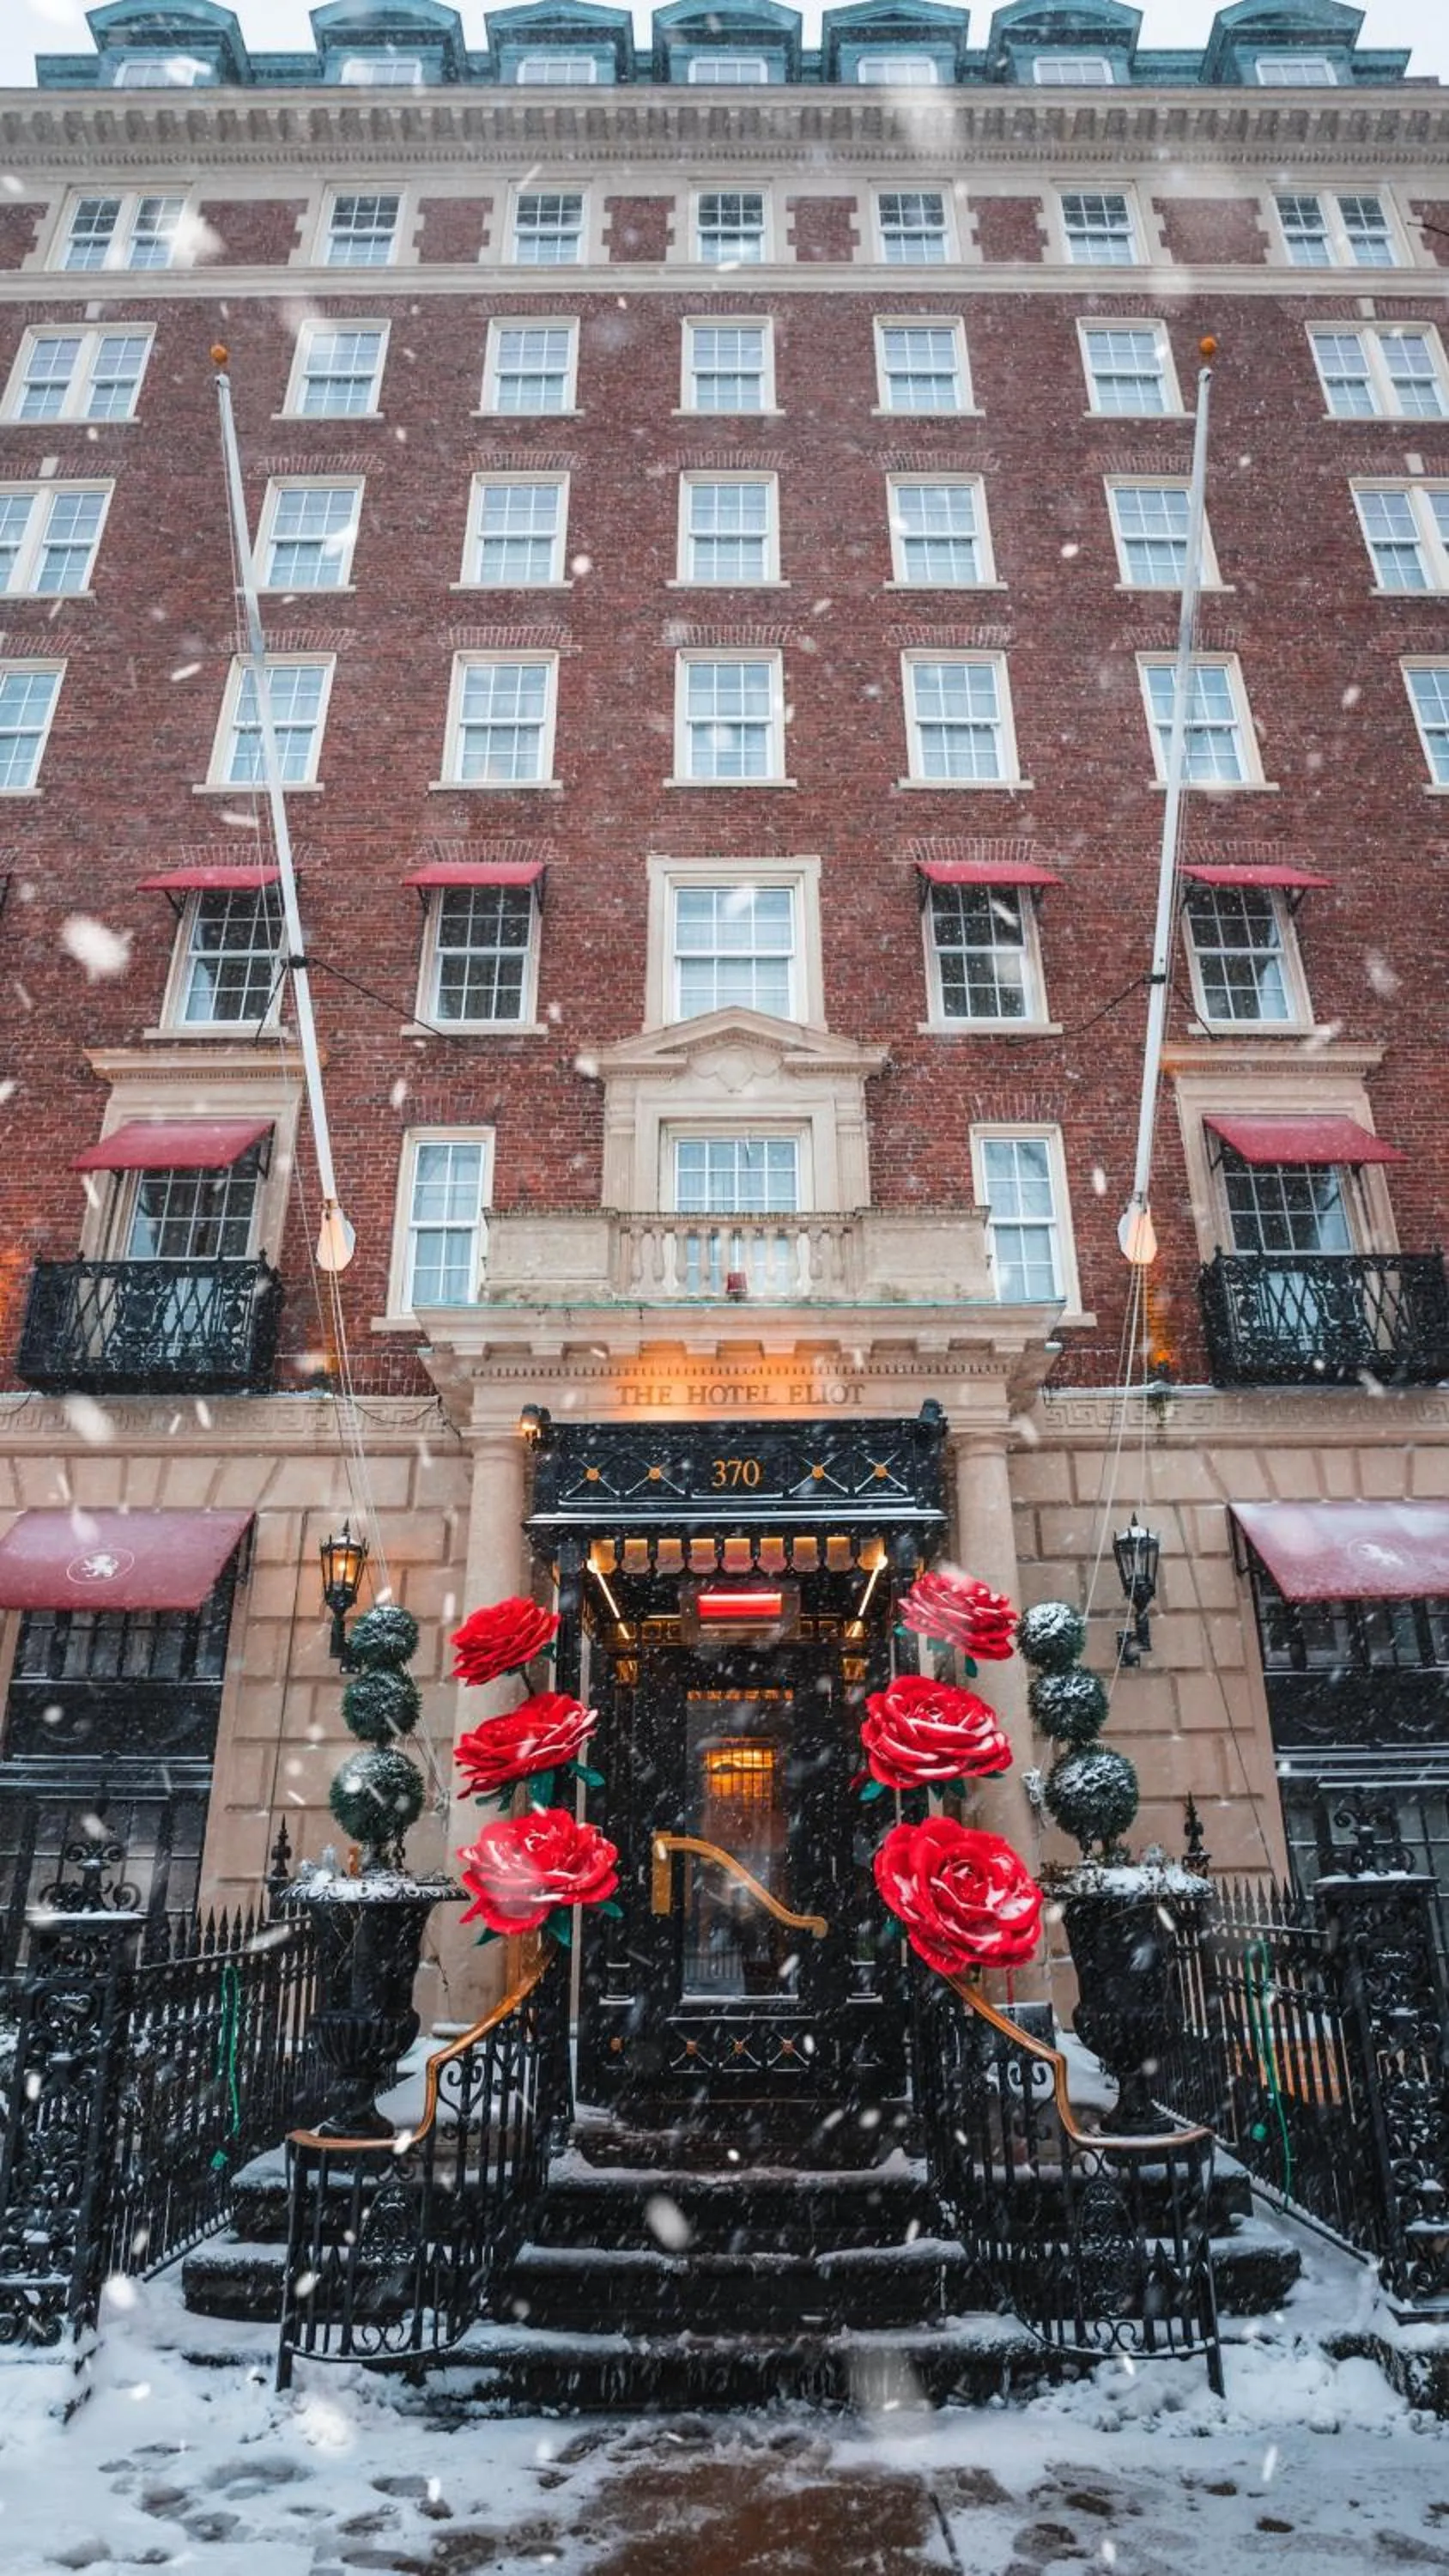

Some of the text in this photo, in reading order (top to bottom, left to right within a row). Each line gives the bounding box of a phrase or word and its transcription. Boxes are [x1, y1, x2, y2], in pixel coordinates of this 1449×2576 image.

[615, 1383, 865, 1406] THE HOTEL ELIOT
[712, 1459, 760, 1488] 370
